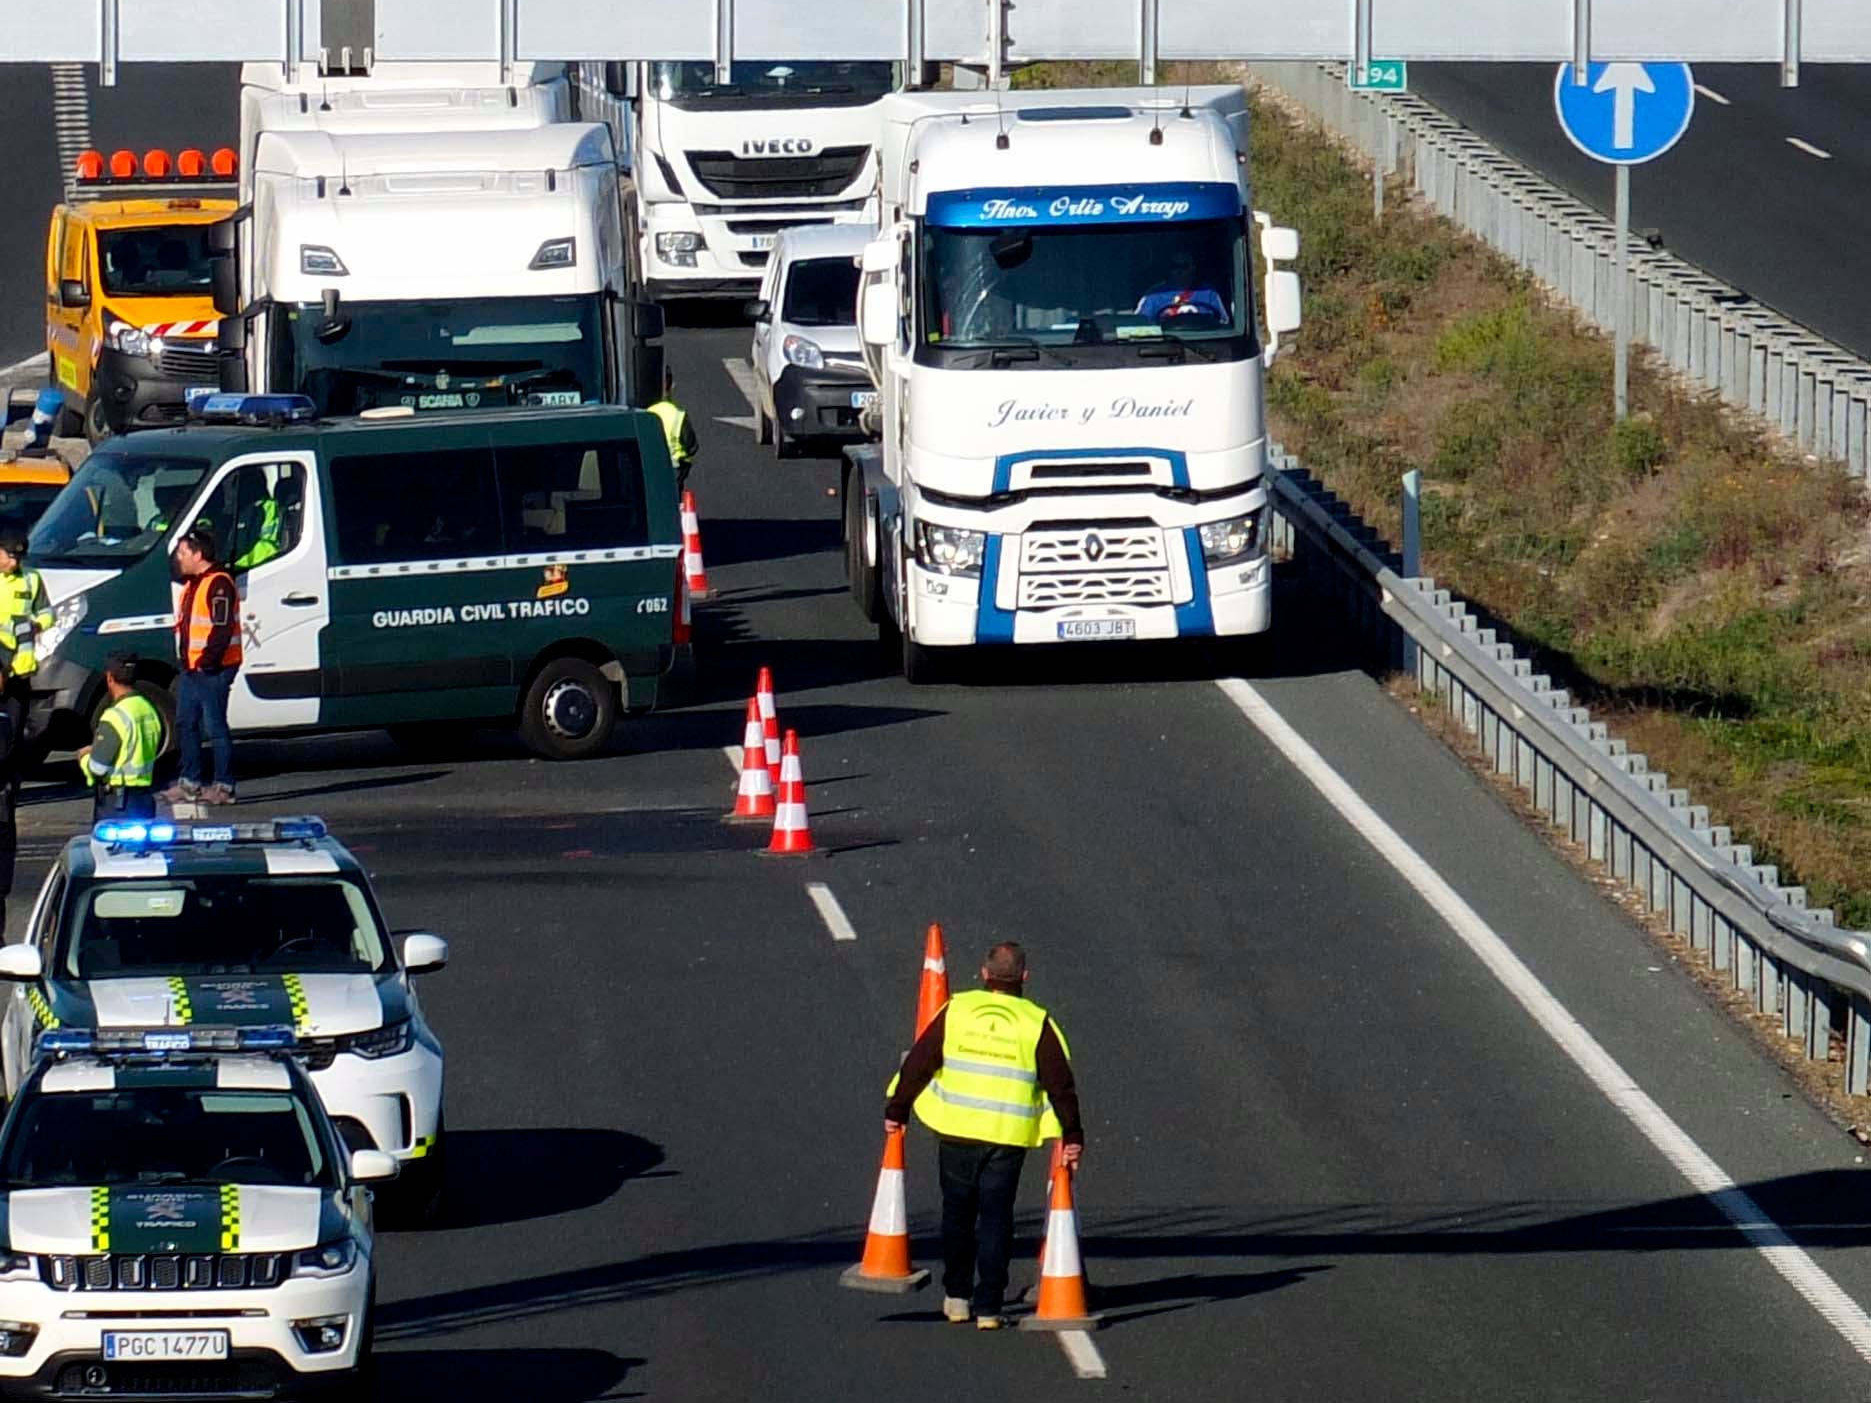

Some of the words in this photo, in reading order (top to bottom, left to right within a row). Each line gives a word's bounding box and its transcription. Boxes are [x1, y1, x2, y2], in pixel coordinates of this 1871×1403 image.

[743, 139, 812, 154] IVECO
[988, 399, 1068, 427] Javier
[1078, 407, 1096, 425] y
[1108, 396, 1194, 418] Daniel
[373, 602, 455, 629] GUARDIA
[460, 602, 505, 622] CIVIL
[508, 598, 590, 618] TRAFICO
[1067, 622, 1100, 635] 4603
[118, 1337, 156, 1356] PGC
